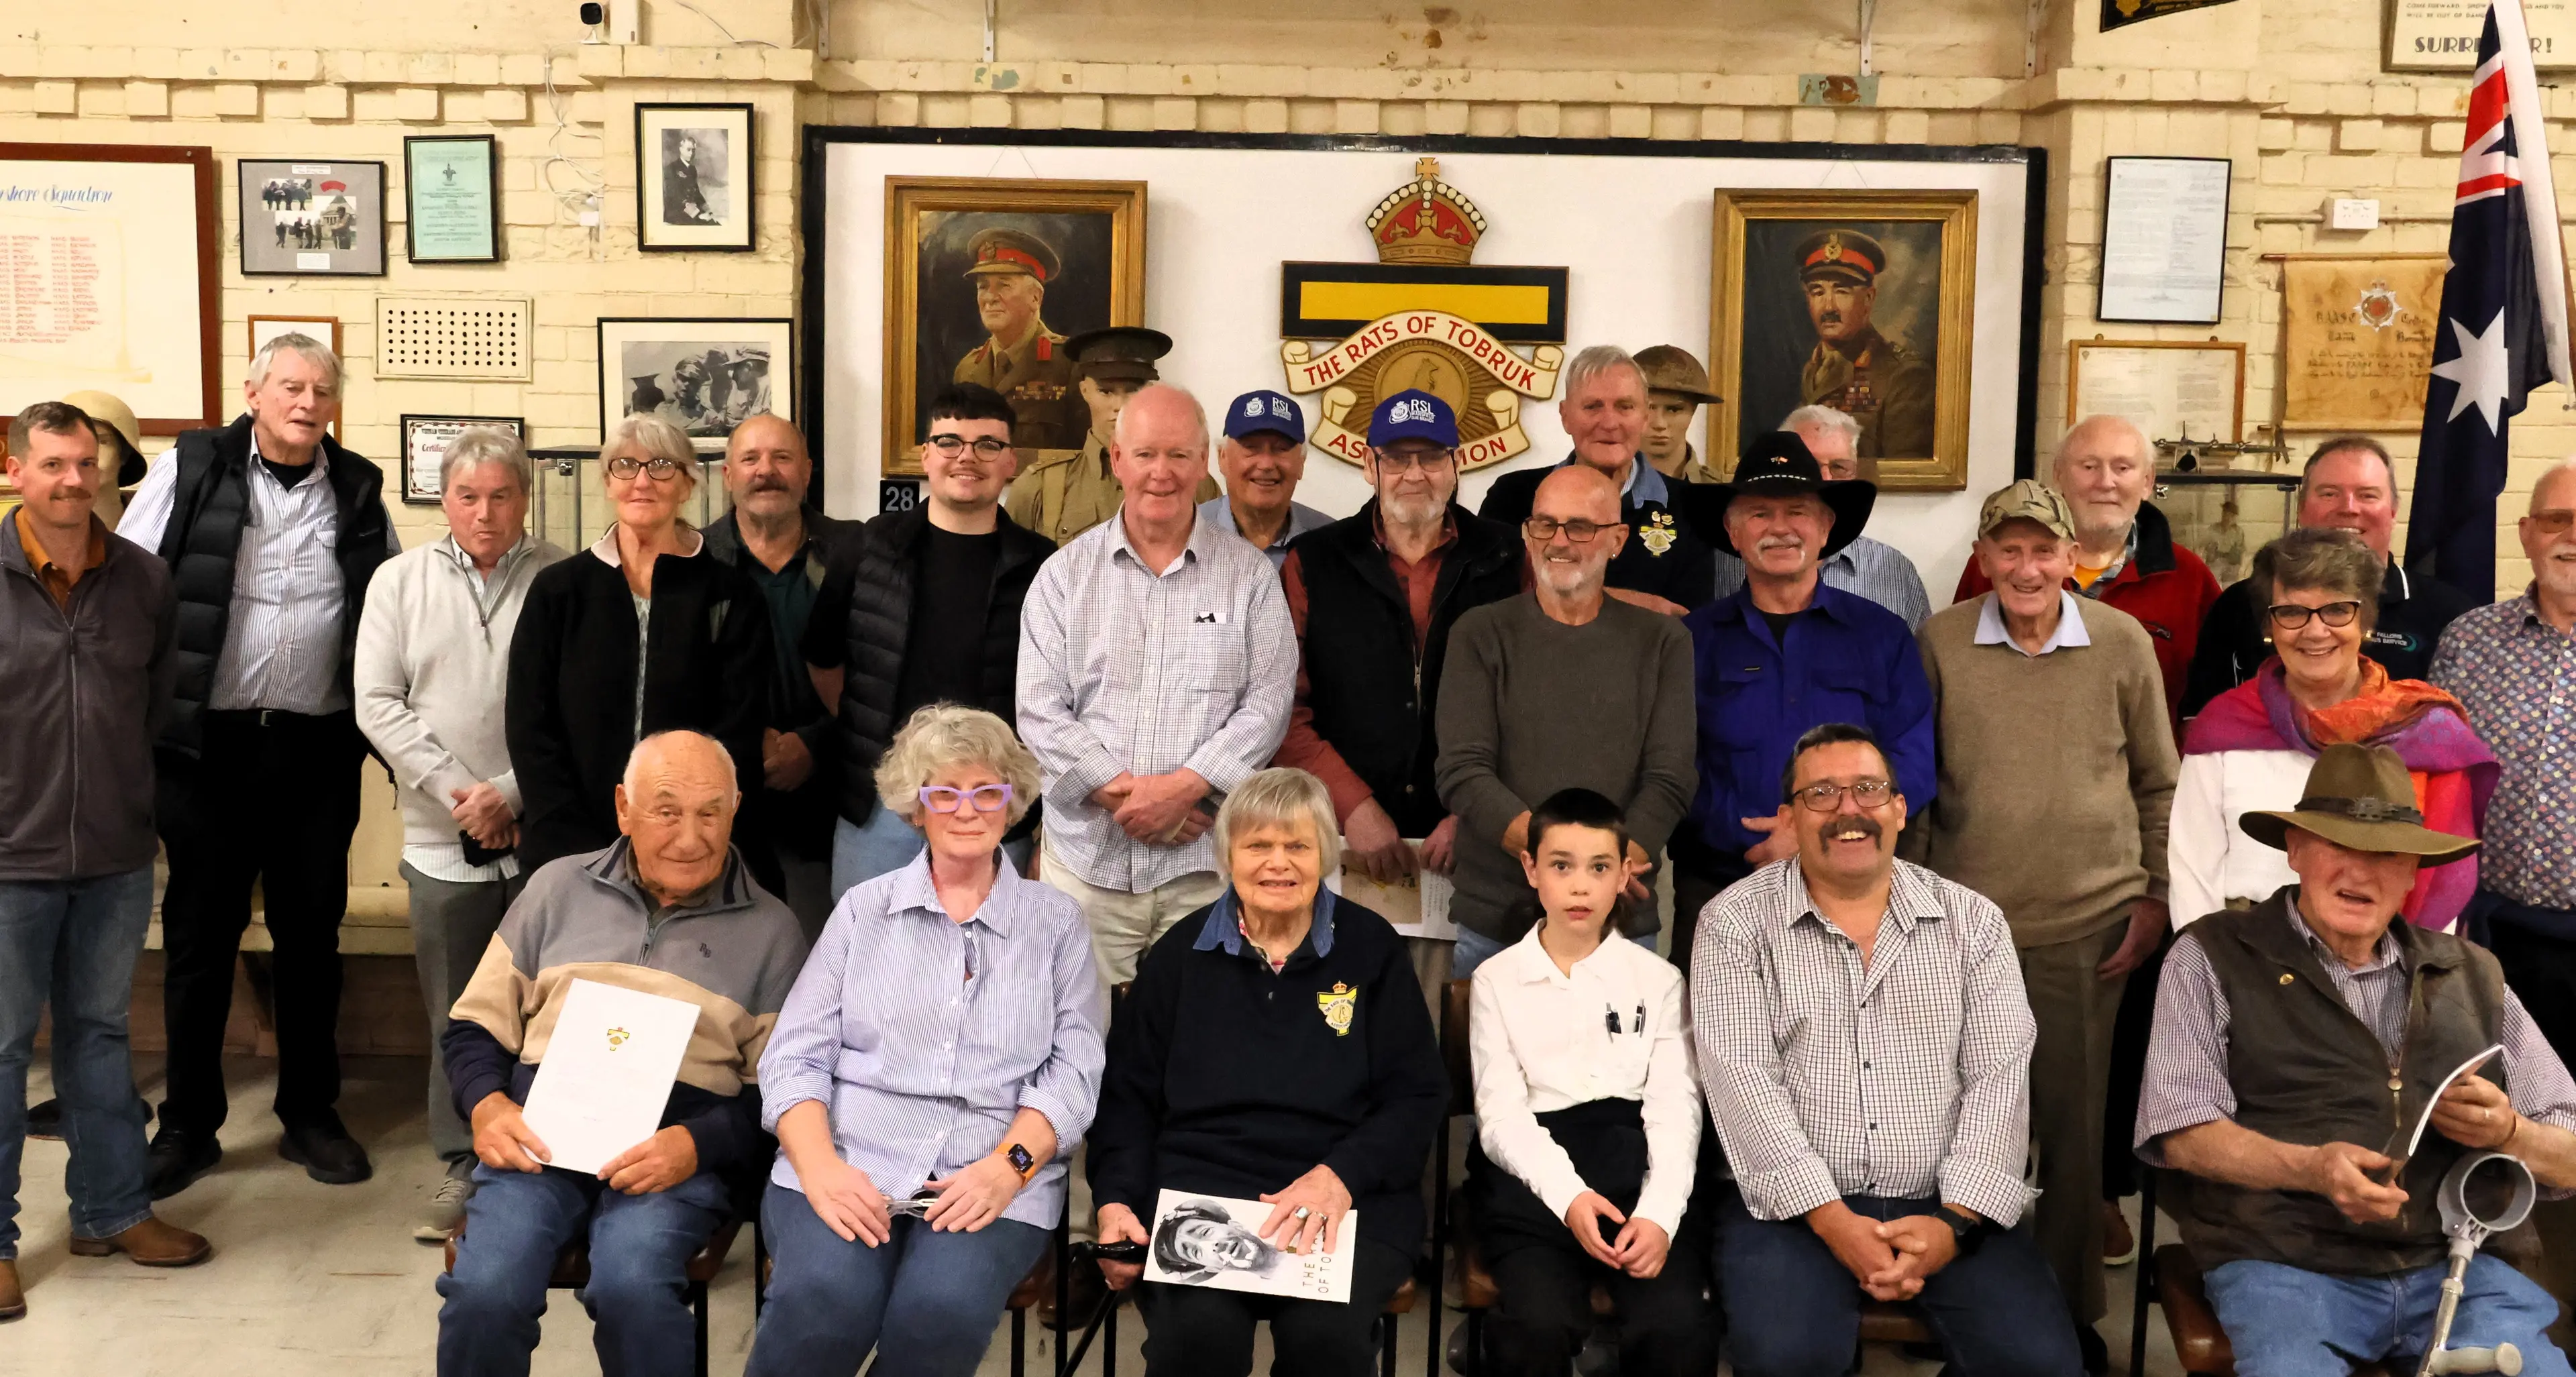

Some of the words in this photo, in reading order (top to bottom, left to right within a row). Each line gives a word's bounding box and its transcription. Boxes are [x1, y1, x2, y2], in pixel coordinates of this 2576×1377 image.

[0, 185, 40, 203] shore
[1303, 355, 1344, 386] THE
[1345, 321, 1399, 364] RATS
[1407, 316, 1436, 335] OF
[1446, 320, 1536, 391] TOBRUK
[1272, 396, 1289, 412] RSL
[1411, 399, 1433, 413] RSL
[885, 486, 914, 511] 28
[1302, 1262, 1315, 1286] THE
[1318, 1278, 1329, 1293] OF
